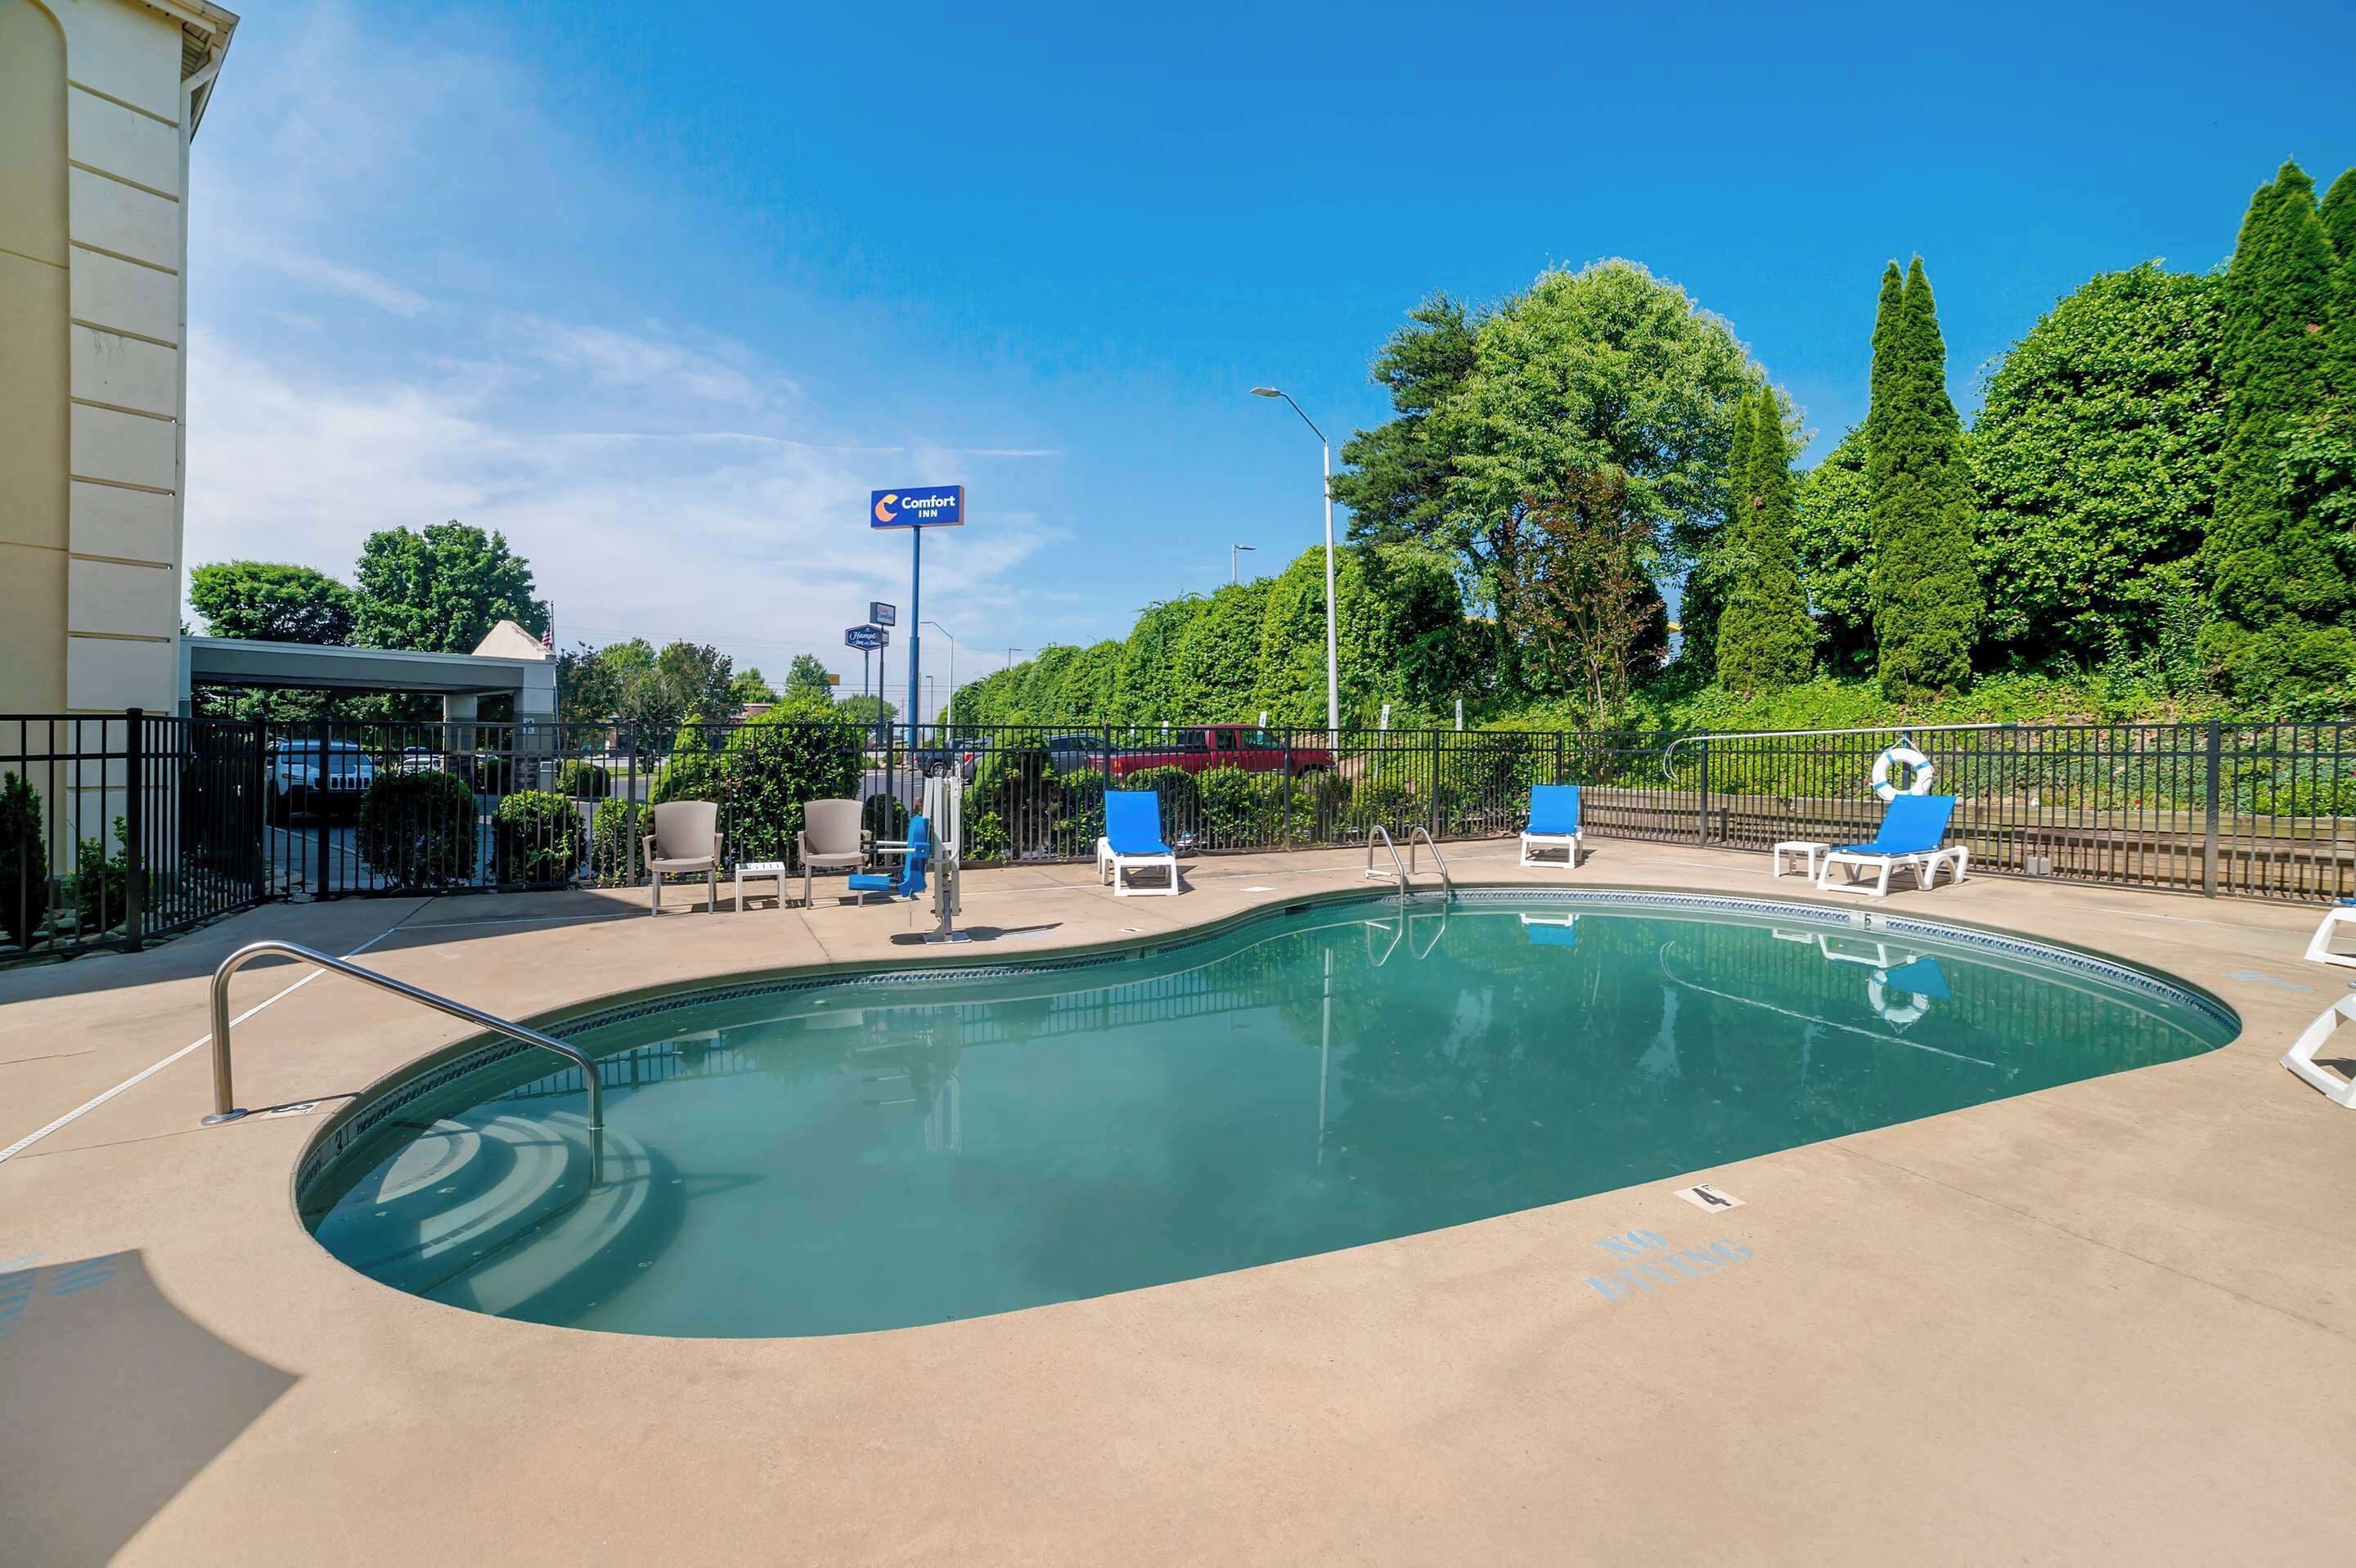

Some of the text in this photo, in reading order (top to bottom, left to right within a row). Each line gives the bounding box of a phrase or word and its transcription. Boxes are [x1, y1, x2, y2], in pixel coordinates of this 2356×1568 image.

[901, 495, 955, 509] Comfort
[919, 510, 937, 518] INN
[849, 631, 877, 640] Hampt
[1692, 1188, 1732, 1206] 4
[1591, 1229, 1668, 1260] NO
